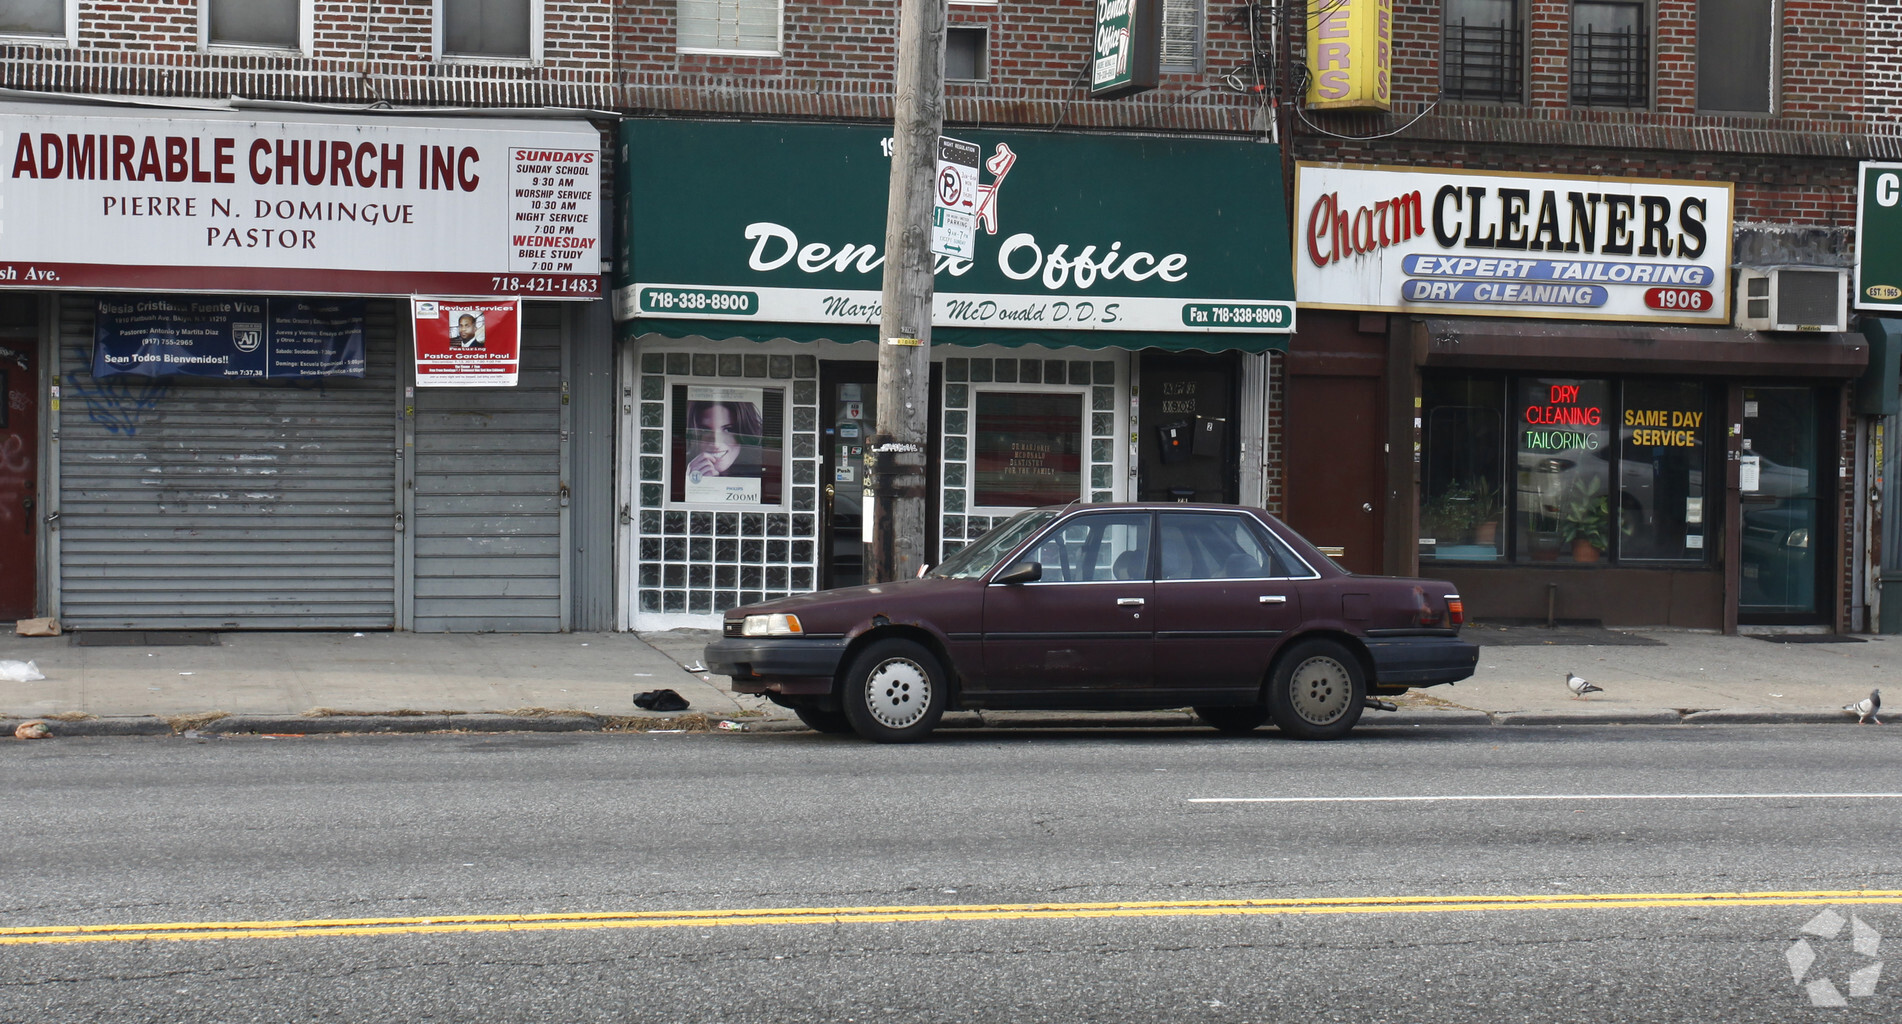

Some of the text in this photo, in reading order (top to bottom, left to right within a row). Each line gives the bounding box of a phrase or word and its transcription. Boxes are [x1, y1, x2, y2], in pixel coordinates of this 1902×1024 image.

[1097, 25, 1121, 56] Office
[12, 132, 480, 192] ADMIRABLE CHURCH INC
[515, 150, 594, 163] SUNDAYS
[516, 164, 590, 175] SUNDAY SCHOOL
[532, 177, 574, 187] 9:30 AM
[515, 189, 592, 200] WORSHIP SERVICE
[103, 197, 414, 225] PIERRE N. DOMINGUE
[531, 200, 576, 210] 10:30 AM
[515, 212, 589, 223] NIGHT SERVICE
[947, 219, 968, 228] PARKING
[534, 225, 574, 235] 7:00 PM
[1307, 184, 1707, 268] Charm CLEANERS
[206, 227, 317, 249] PASTOR
[512, 235, 596, 249] WEDNESDAY
[518, 249, 583, 259] BIBLE STUDY
[998, 233, 1188, 290] Office
[531, 261, 573, 271] 7:00 PM
[1414, 256, 1704, 285] EXPERT TAILORING
[24, 267, 60, 281] Ave.
[491, 277, 597, 292] 718-421-1483
[1414, 280, 1592, 305] DRY CLEANING
[1657, 289, 1702, 309] 1906
[1884, 288, 1898, 297] 1965
[99, 301, 134, 314] Iglesia
[192, 302, 231, 313] Fuente
[234, 301, 260, 313] Viva
[649, 292, 749, 310] 718-338-8900
[946, 300, 1045, 322] McDonald
[1190, 307, 1283, 324] Fax 718-338-8909
[150, 327, 175, 335] Antonio
[181, 328, 204, 336] Martita
[142, 338, 159, 346] (917)
[104, 353, 229, 364] Sean Todos Bienvenidos!!
[1550, 385, 1580, 403] DRY
[1526, 406, 1600, 426] CLEANING
[1625, 409, 1703, 427] SAME DAY
[1526, 431, 1599, 450] TAILORING
[1632, 429, 1695, 447] SERVICE
